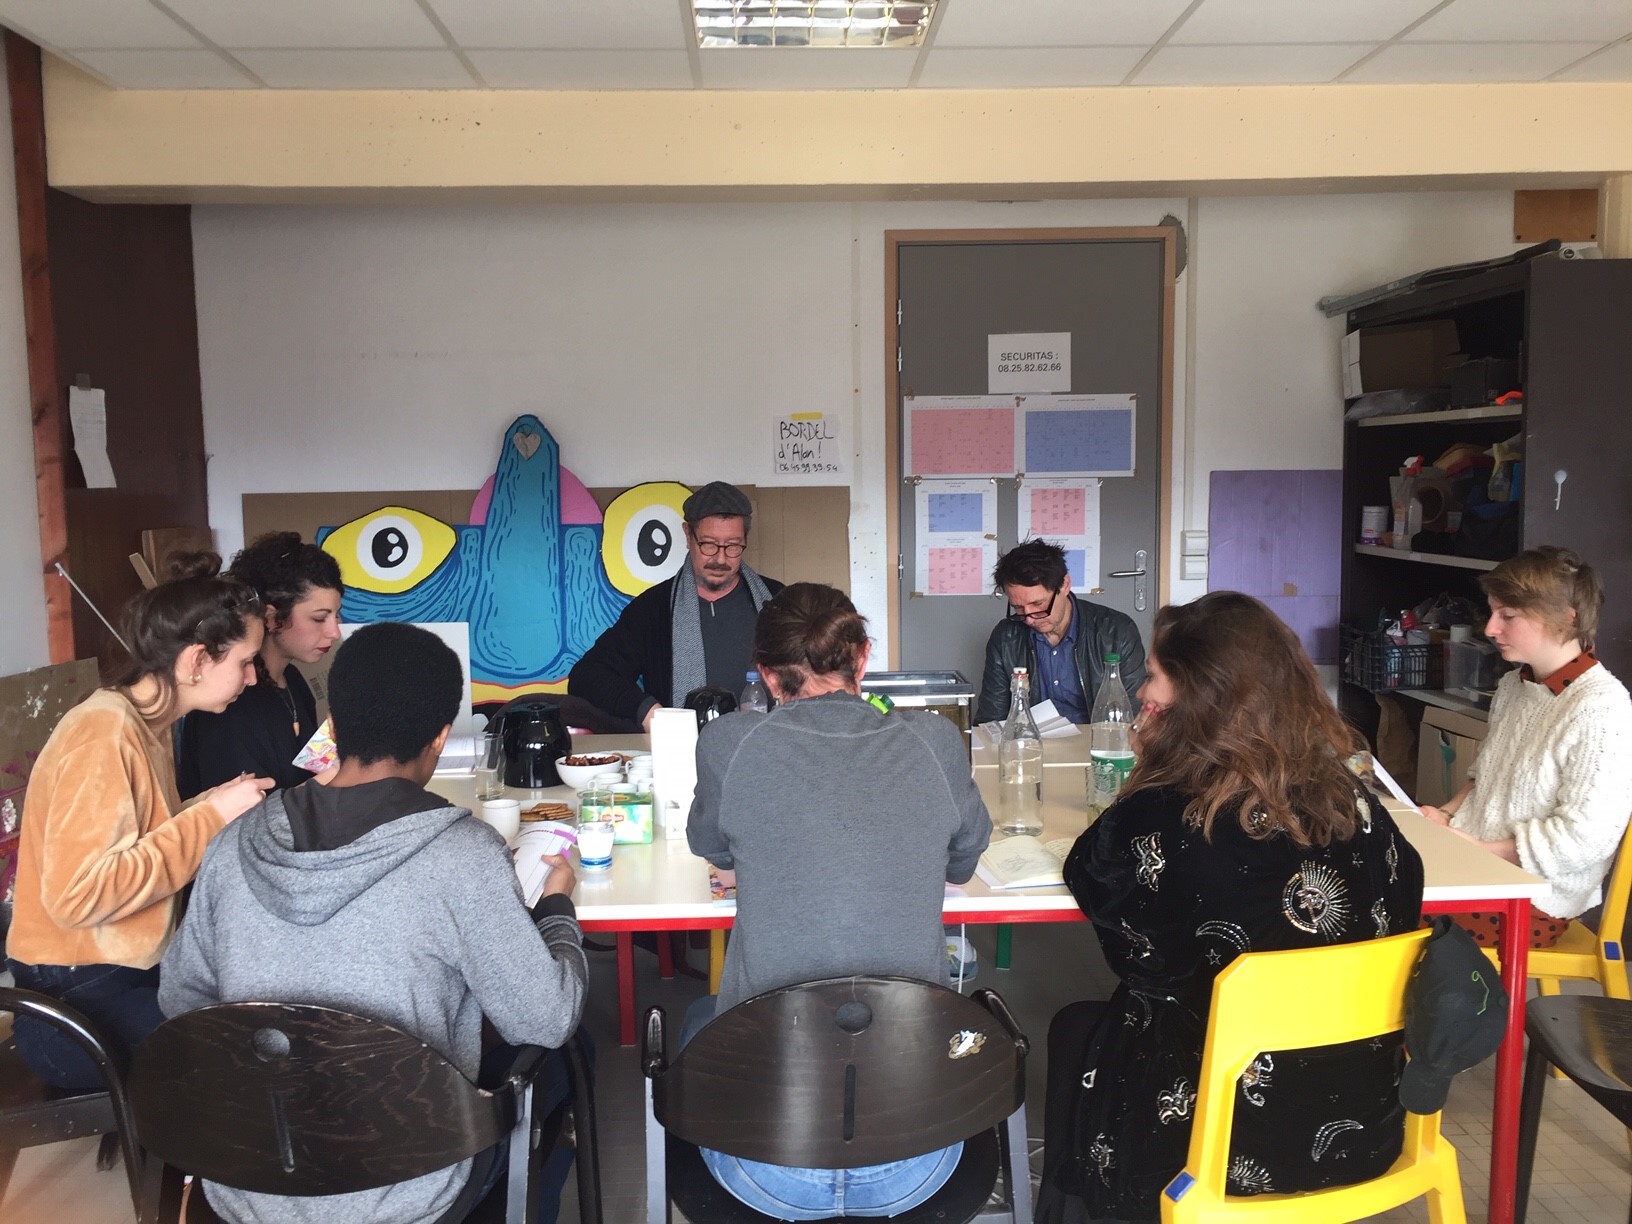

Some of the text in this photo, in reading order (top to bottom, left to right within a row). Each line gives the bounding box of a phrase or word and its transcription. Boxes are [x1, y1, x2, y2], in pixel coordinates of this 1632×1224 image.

[1000, 351, 1054, 361] SECURITAS
[997, 362, 1062, 373] 08.25.82.62.66
[780, 420, 835, 442] BORDEL
